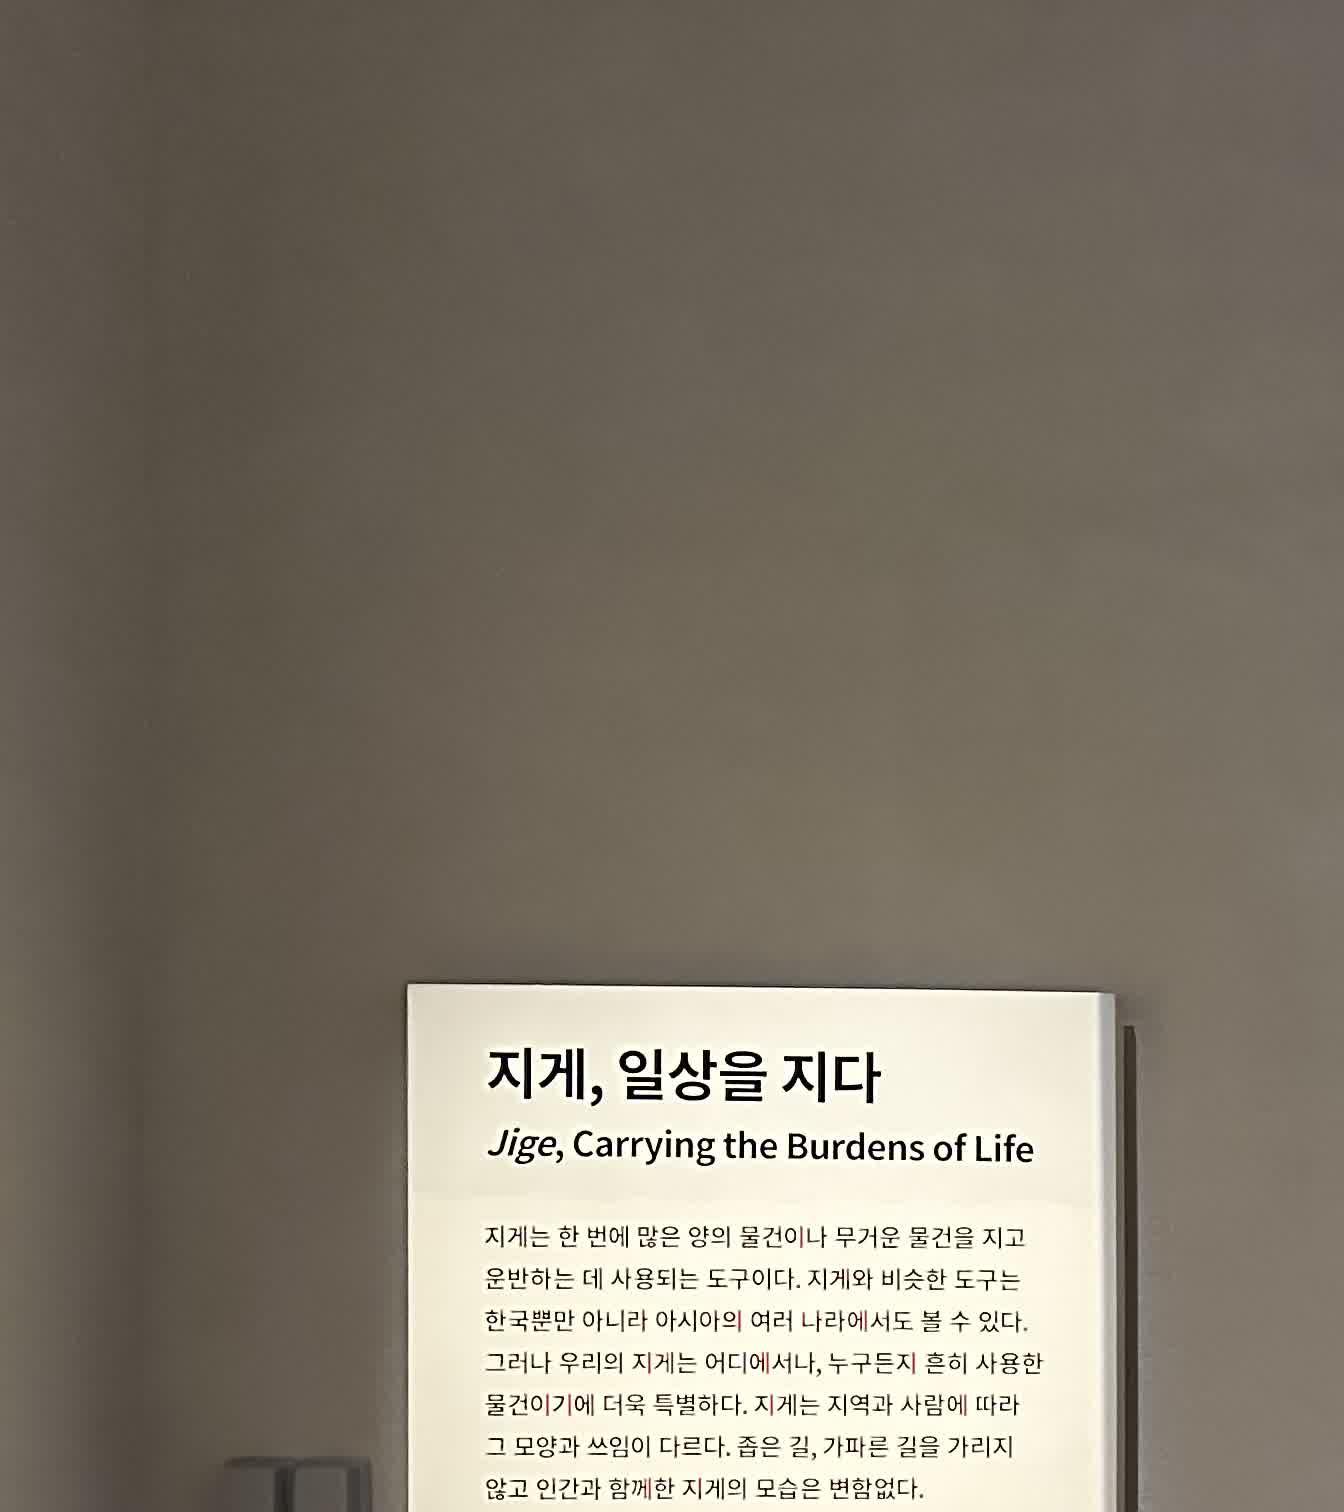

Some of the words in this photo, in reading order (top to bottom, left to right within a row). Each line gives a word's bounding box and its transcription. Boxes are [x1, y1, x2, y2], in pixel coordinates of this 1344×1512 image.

[487, 1046, 604, 1108] 지게,
[618, 1047, 769, 1103] 일상을
[781, 1050, 883, 1105] 지다
[487, 1127, 564, 1165] Jige,
[573, 1128, 716, 1167] Carrying
[722, 1129, 778, 1160] the
[787, 1131, 925, 1162] Burdens
[933, 1132, 969, 1162] of
[975, 1133, 1035, 1164] Life
[484, 1224, 551, 1249] 지게는
[557, 1224, 580, 1249] 한
[587, 1224, 629, 1249] 번에
[637, 1224, 681, 1249] 많은
[688, 1224, 731, 1249] 양의
[739, 1225, 828, 1249] 물건이나
[834, 1225, 901, 1249] 무거운
[908, 1225, 975, 1250] 물건을
[981, 1226, 1026, 1251] 지고
[484, 1266, 576, 1291] 운반하는
[582, 1266, 603, 1291] 데
[610, 1266, 700, 1292] 사용되는
[706, 1266, 801, 1292] 도구이다.
[807, 1267, 874, 1292] 지게와
[881, 1267, 948, 1292] 비슷한
[953, 1269, 1021, 1293] 도구는
[484, 1308, 576, 1333] 한국뿐만
[582, 1308, 649, 1333] 아니라
[655, 1308, 742, 1334] 아시아의
[750, 1309, 793, 1334] 여러
[801, 1309, 914, 1333] 나라에서도
[920, 1309, 943, 1333] 볼
[949, 1309, 972, 1334] 수
[978, 1309, 1029, 1334] 있다.
[484, 1351, 553, 1375] 그러나
[559, 1351, 623, 1375] 우리의
[631, 1351, 697, 1375] 지게는
[705, 1351, 822, 1378] 어디에서나,
[827, 1351, 916, 1376] 누구든지
[924, 1351, 967, 1376] 흔히
[975, 1351, 1045, 1376] 사용한
[484, 1392, 595, 1417] 물건이기에
[603, 1392, 646, 1417] 더욱
[652, 1392, 748, 1417] 특별하다.
[754, 1393, 821, 1417] 지게는
[827, 1393, 894, 1417] 지역과
[900, 1392, 968, 1417] 사람에
[975, 1393, 1021, 1417] 따라
[484, 1437, 507, 1456] 그
[513, 1434, 581, 1460] 모양과
[586, 1434, 651, 1459] 쓰임이
[659, 1434, 732, 1459] 다르다.
[736, 1435, 782, 1459] 좁은
[789, 1435, 817, 1462] 길,
[823, 1435, 889, 1459] 가파른
[897, 1435, 941, 1459] 길을
[947, 1435, 1013, 1459] 가리지
[485, 1477, 529, 1501] 않고
[536, 1476, 603, 1501] 인간과
[608, 1476, 676, 1501] 함께한
[682, 1476, 747, 1501] 지게의
[754, 1477, 822, 1500] 모습은
[829, 1476, 925, 1501] 변함없다.
